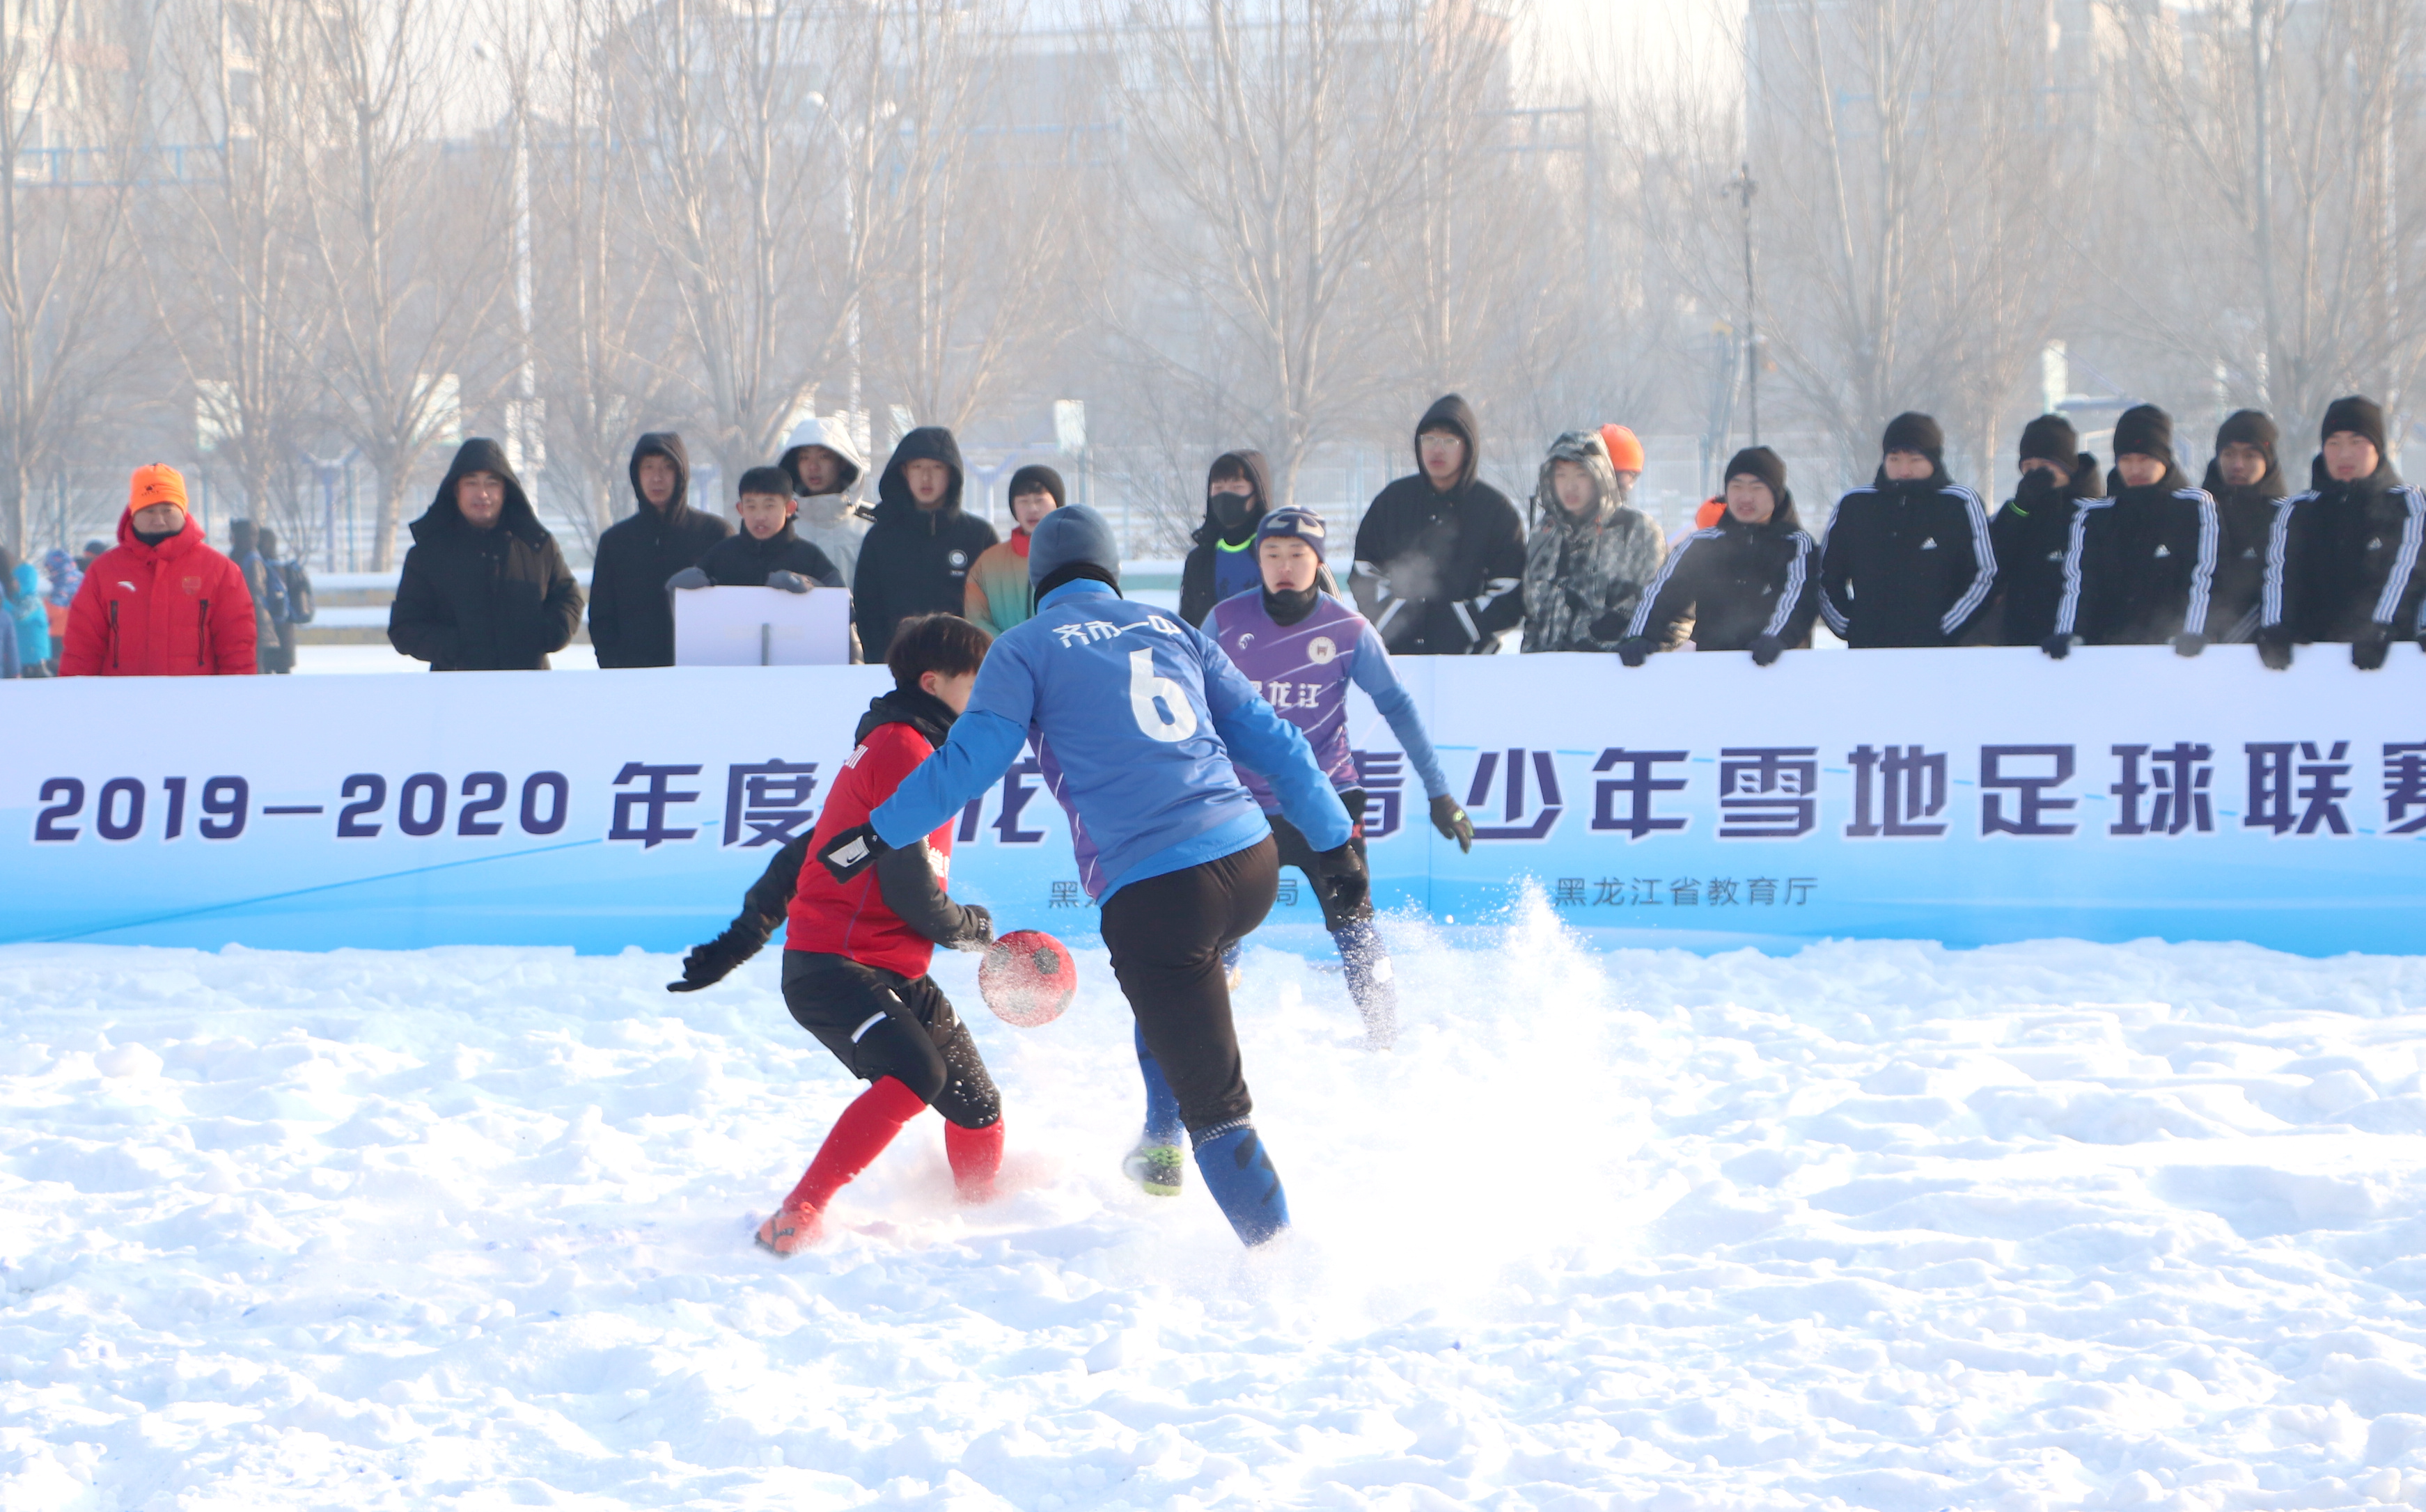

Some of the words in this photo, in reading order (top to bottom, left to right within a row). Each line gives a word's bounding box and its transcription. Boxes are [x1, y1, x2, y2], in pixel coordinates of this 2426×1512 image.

[1129, 646, 1198, 743] 6
[1555, 876, 1818, 906] 黑龙江省教育厅
